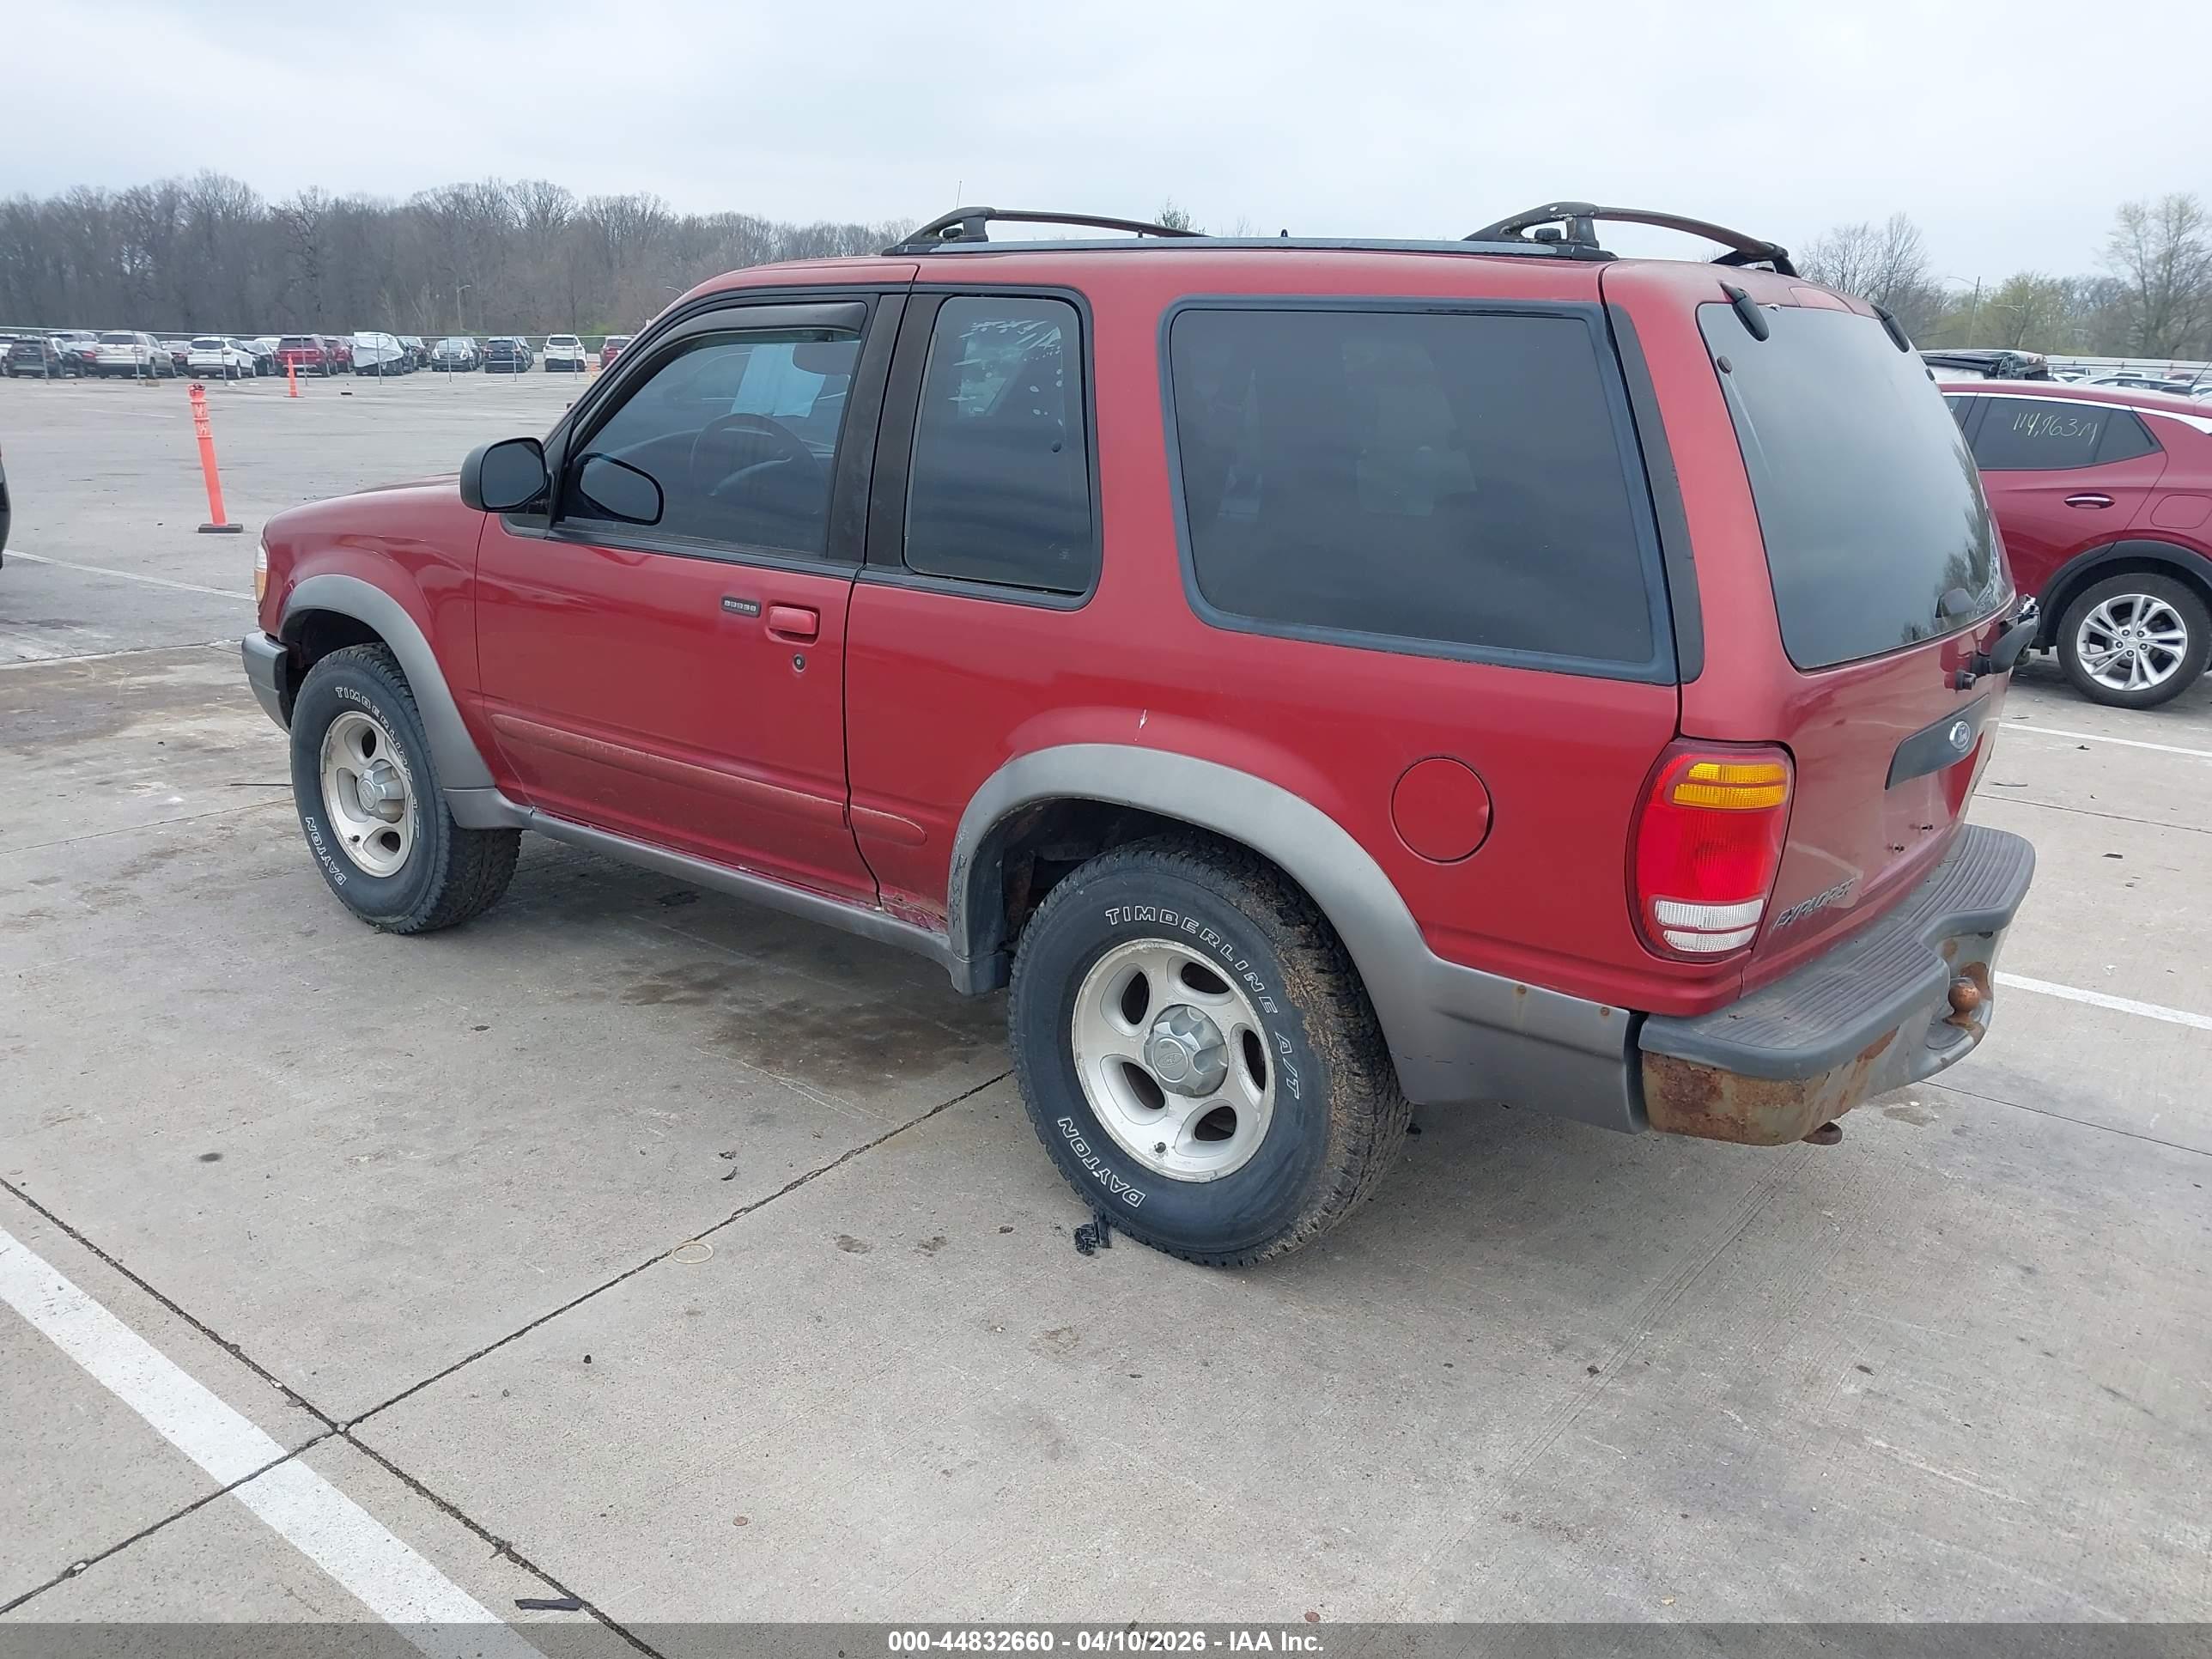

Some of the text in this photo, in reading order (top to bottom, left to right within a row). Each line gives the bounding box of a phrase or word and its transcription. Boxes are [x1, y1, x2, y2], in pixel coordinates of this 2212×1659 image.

[305, 817, 347, 886] DAYTON
[1771, 878, 1856, 930] EXPLORER
[1105, 906, 1302, 1100] TIMBERLINE A/T
[1057, 1117, 1147, 1208] DAYTON
